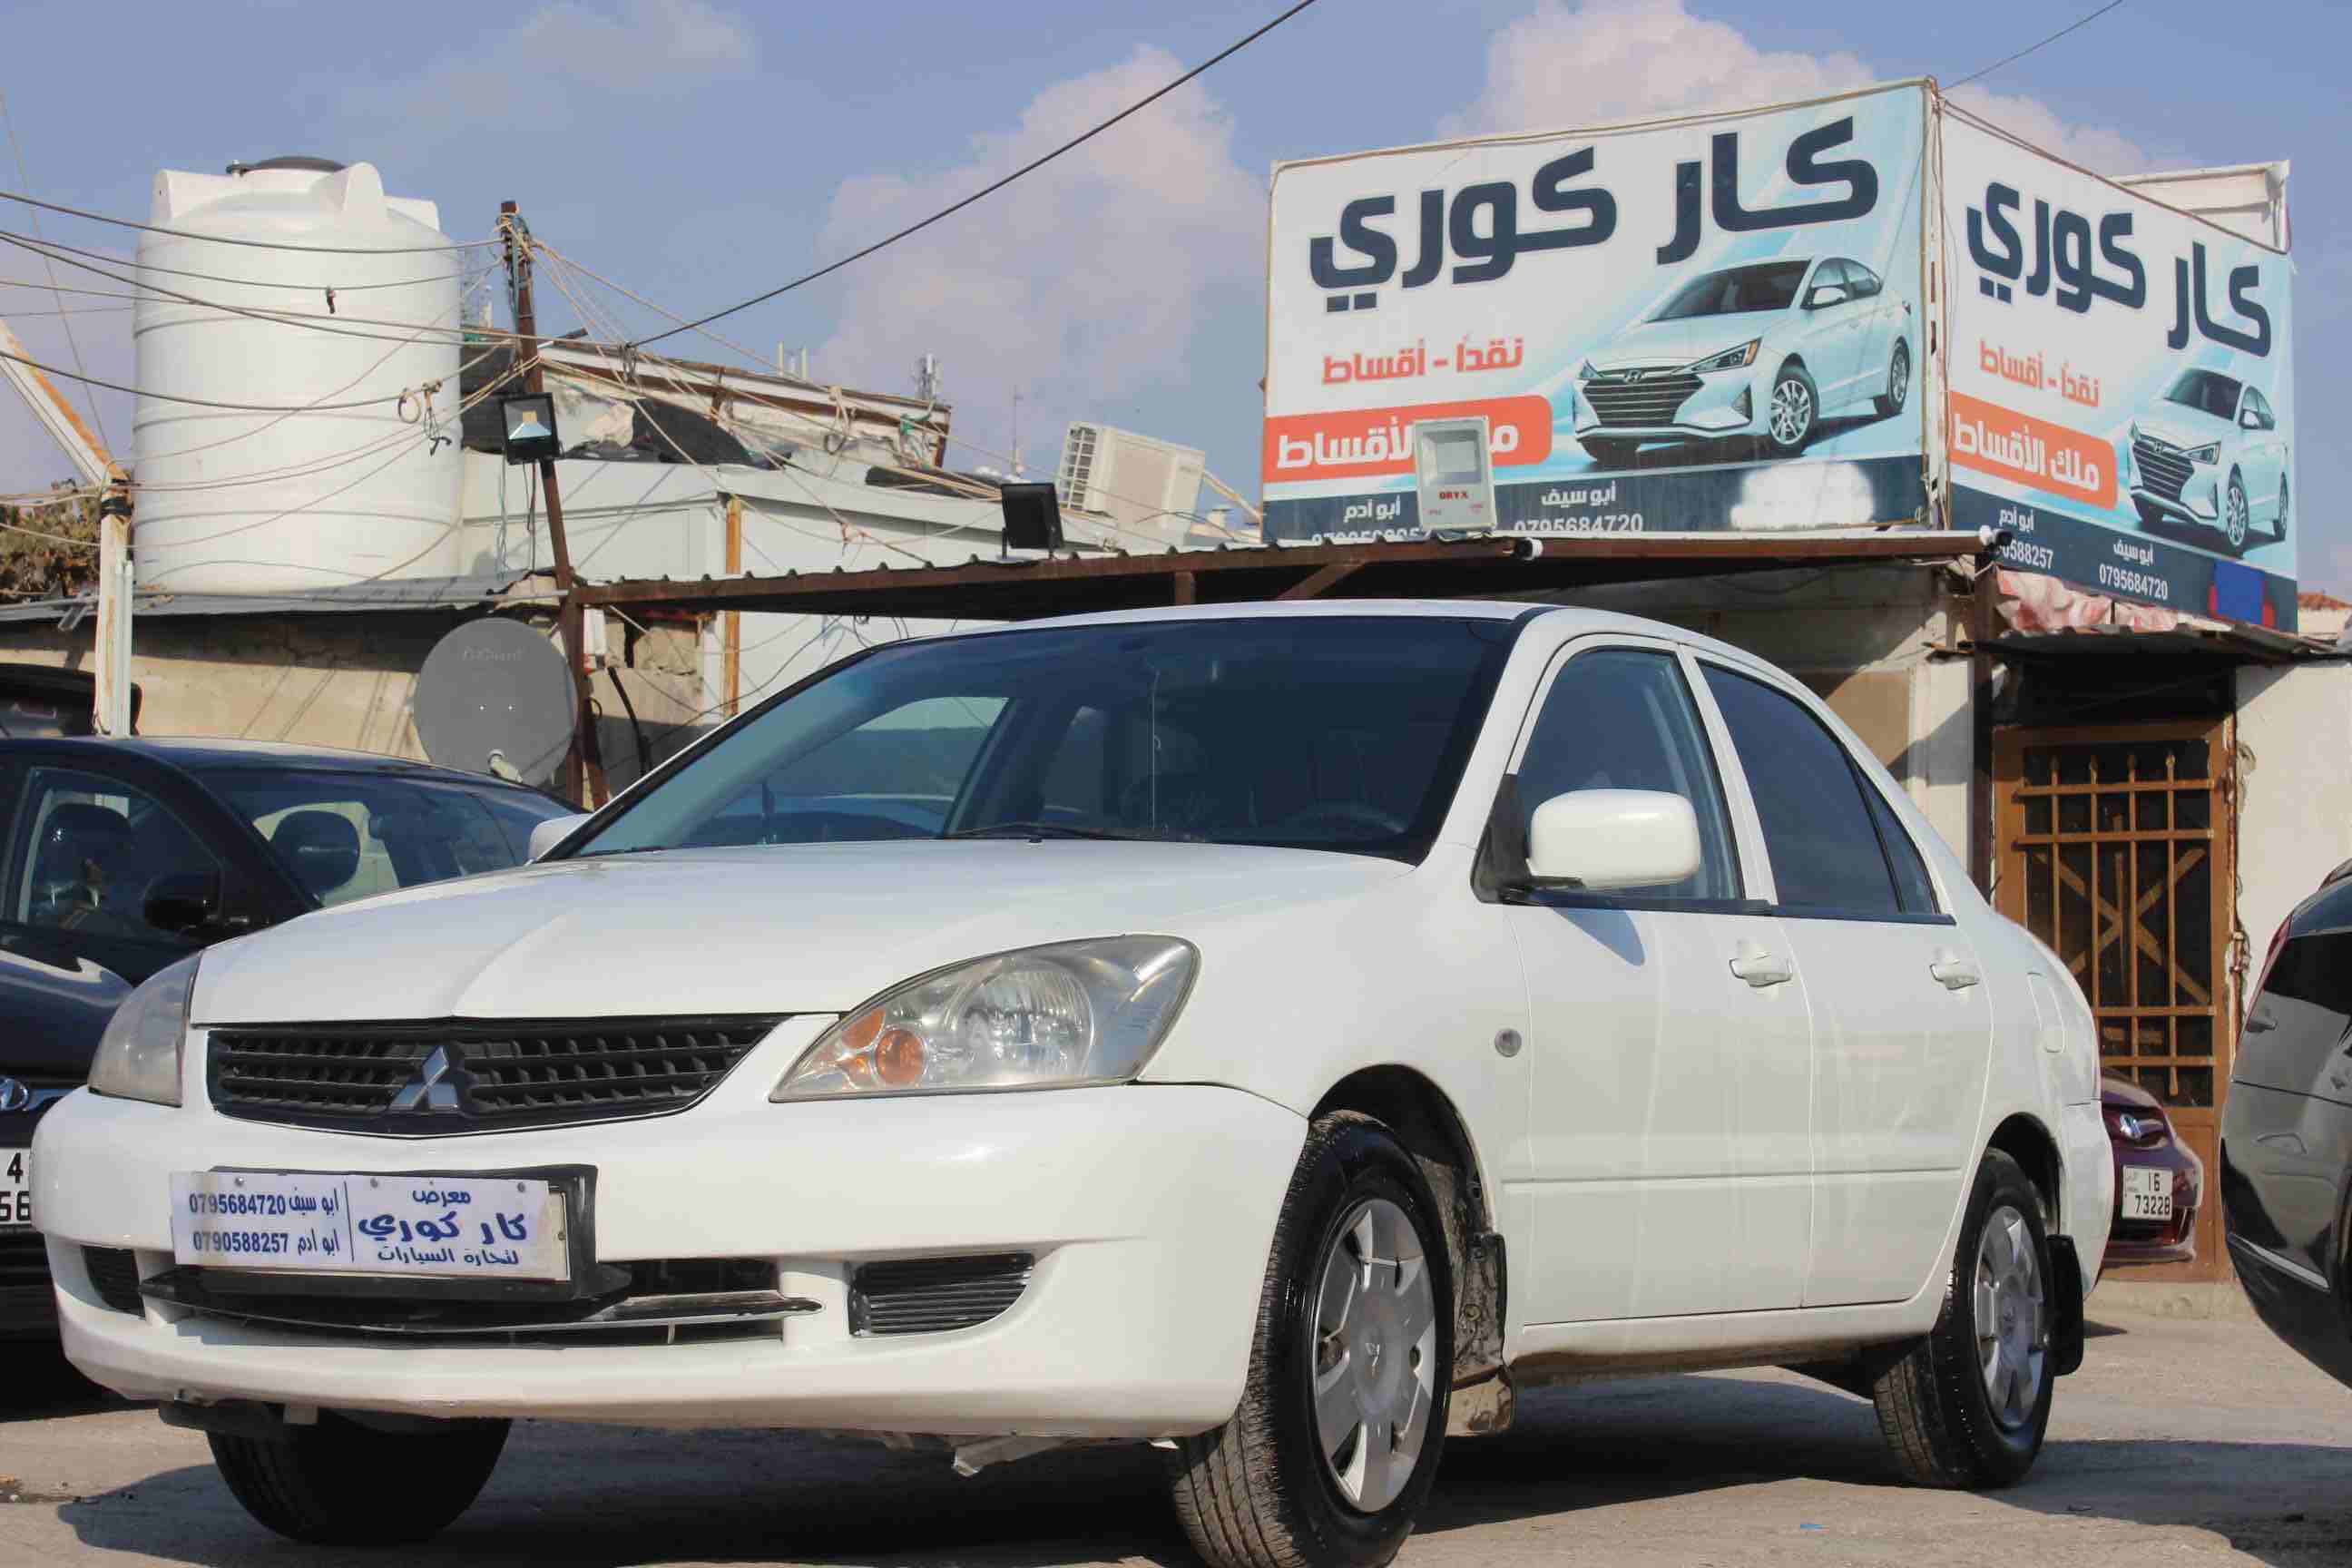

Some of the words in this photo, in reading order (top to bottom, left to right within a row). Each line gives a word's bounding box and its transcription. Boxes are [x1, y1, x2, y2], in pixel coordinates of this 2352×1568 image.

[1656, 115, 1878, 265] كار
[1308, 146, 1618, 313] كوري
[1966, 181, 2147, 314] كوري
[2167, 240, 2271, 358] كار
[1322, 338, 1426, 385] أقساط
[1277, 416, 1415, 469] لأقساط
[1954, 414, 2047, 476] الأقساط
[2050, 447, 2100, 492] ملك
[1541, 488, 1587, 508] سيف
[2113, 539, 2139, 562] سيف
[2099, 564, 2169, 601] 0795684720
[7, 1152, 24, 1183] 4
[189, 1193, 286, 1216] 0795684720
[289, 1186, 317, 1216] سيف
[412, 1181, 471, 1207] معرض
[2134, 1194, 2171, 1216] 73228
[192, 1230, 289, 1253] 0790588257
[358, 1210, 460, 1242] كوري
[480, 1212, 527, 1244] كار
[377, 1246, 456, 1265] السيارات
